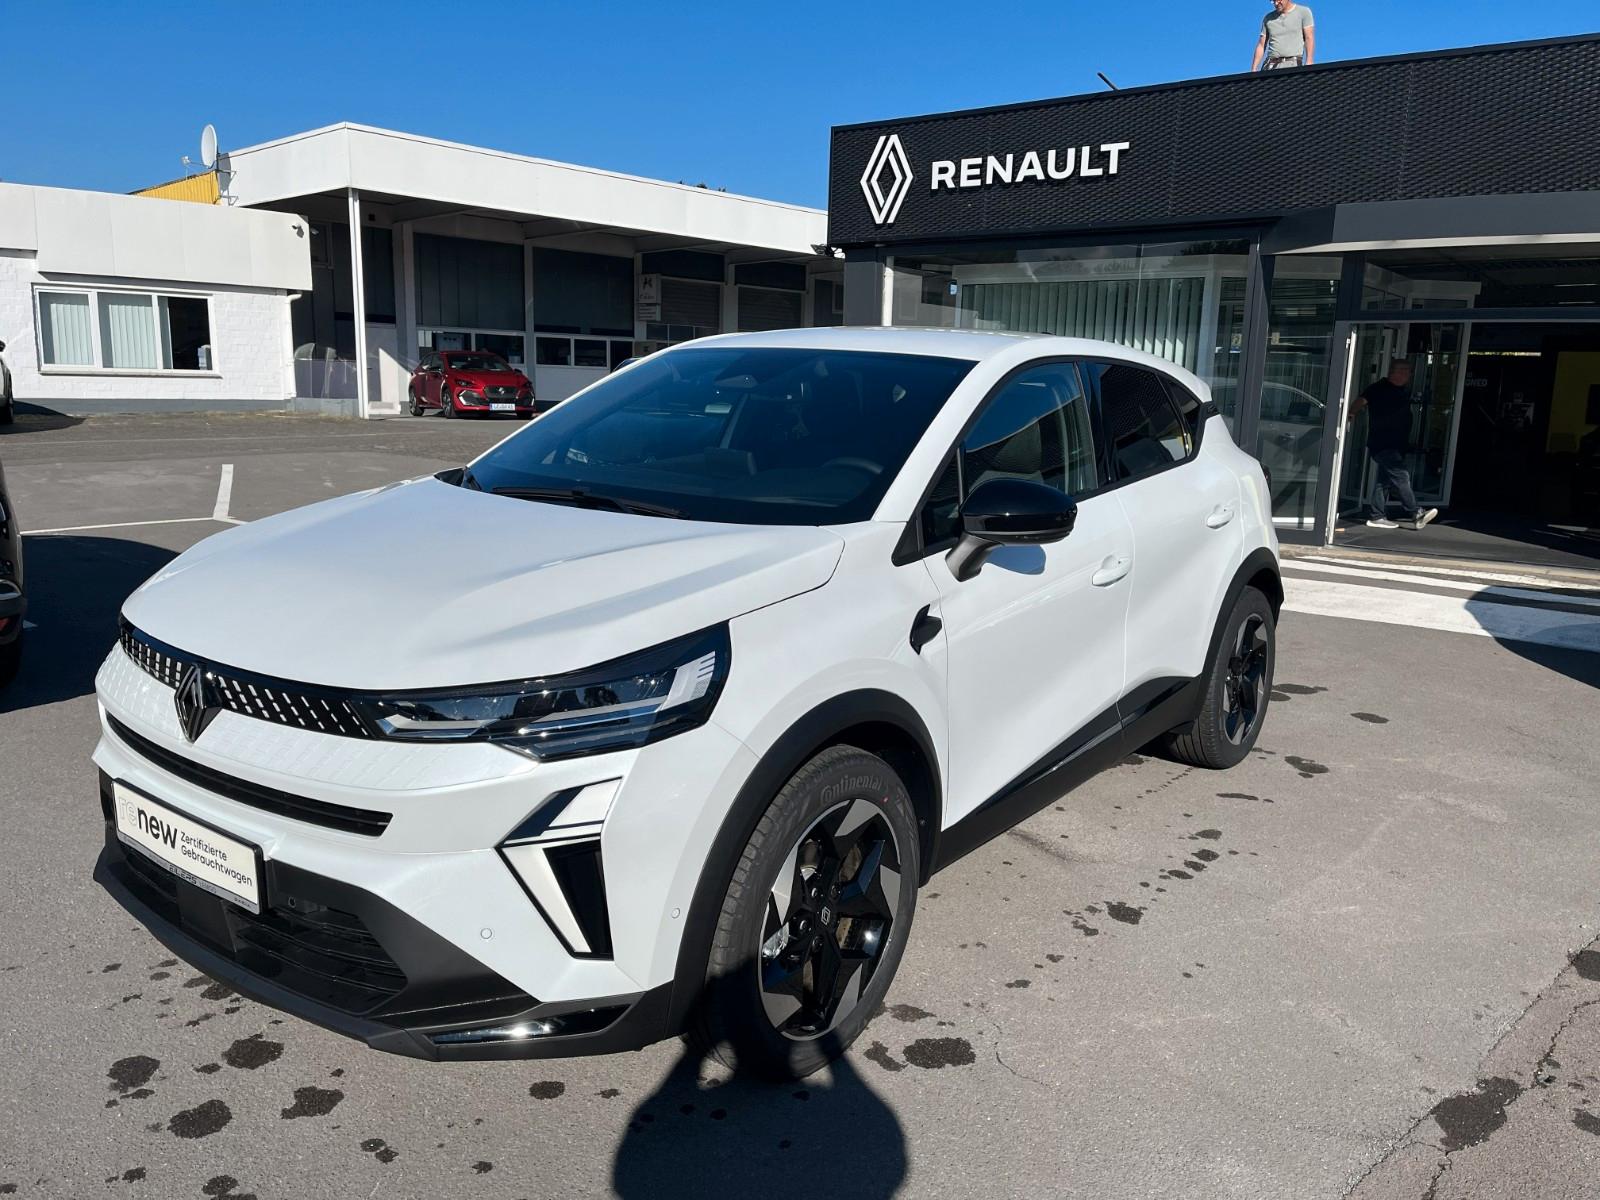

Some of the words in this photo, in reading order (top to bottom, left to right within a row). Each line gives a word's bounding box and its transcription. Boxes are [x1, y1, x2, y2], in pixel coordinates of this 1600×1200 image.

[931, 142, 1130, 190] RENAULT
[820, 774, 882, 803] Continental
[180, 831, 227, 861] Zertifizierte
[181, 844, 252, 886] Gebrauchtwagen
